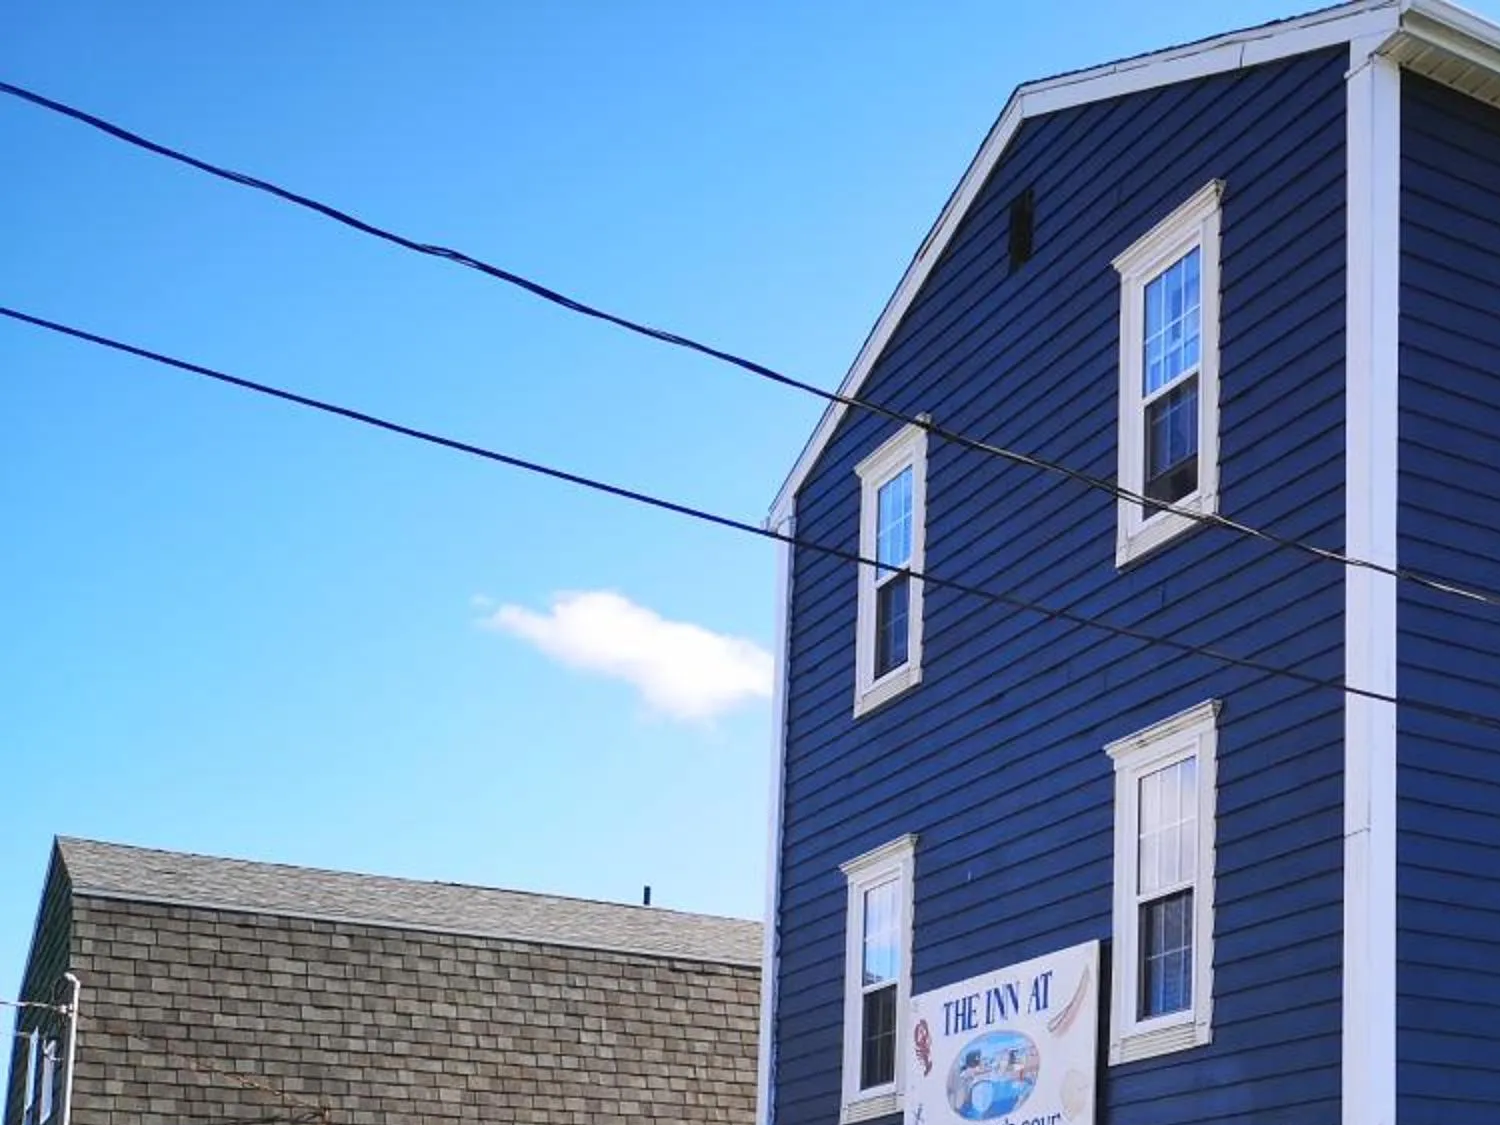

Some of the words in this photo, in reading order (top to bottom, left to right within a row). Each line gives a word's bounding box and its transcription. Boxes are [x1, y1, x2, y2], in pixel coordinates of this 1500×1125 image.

[943, 993, 980, 1036] THE
[985, 981, 1020, 1024] INN
[1027, 970, 1052, 1014] AT
